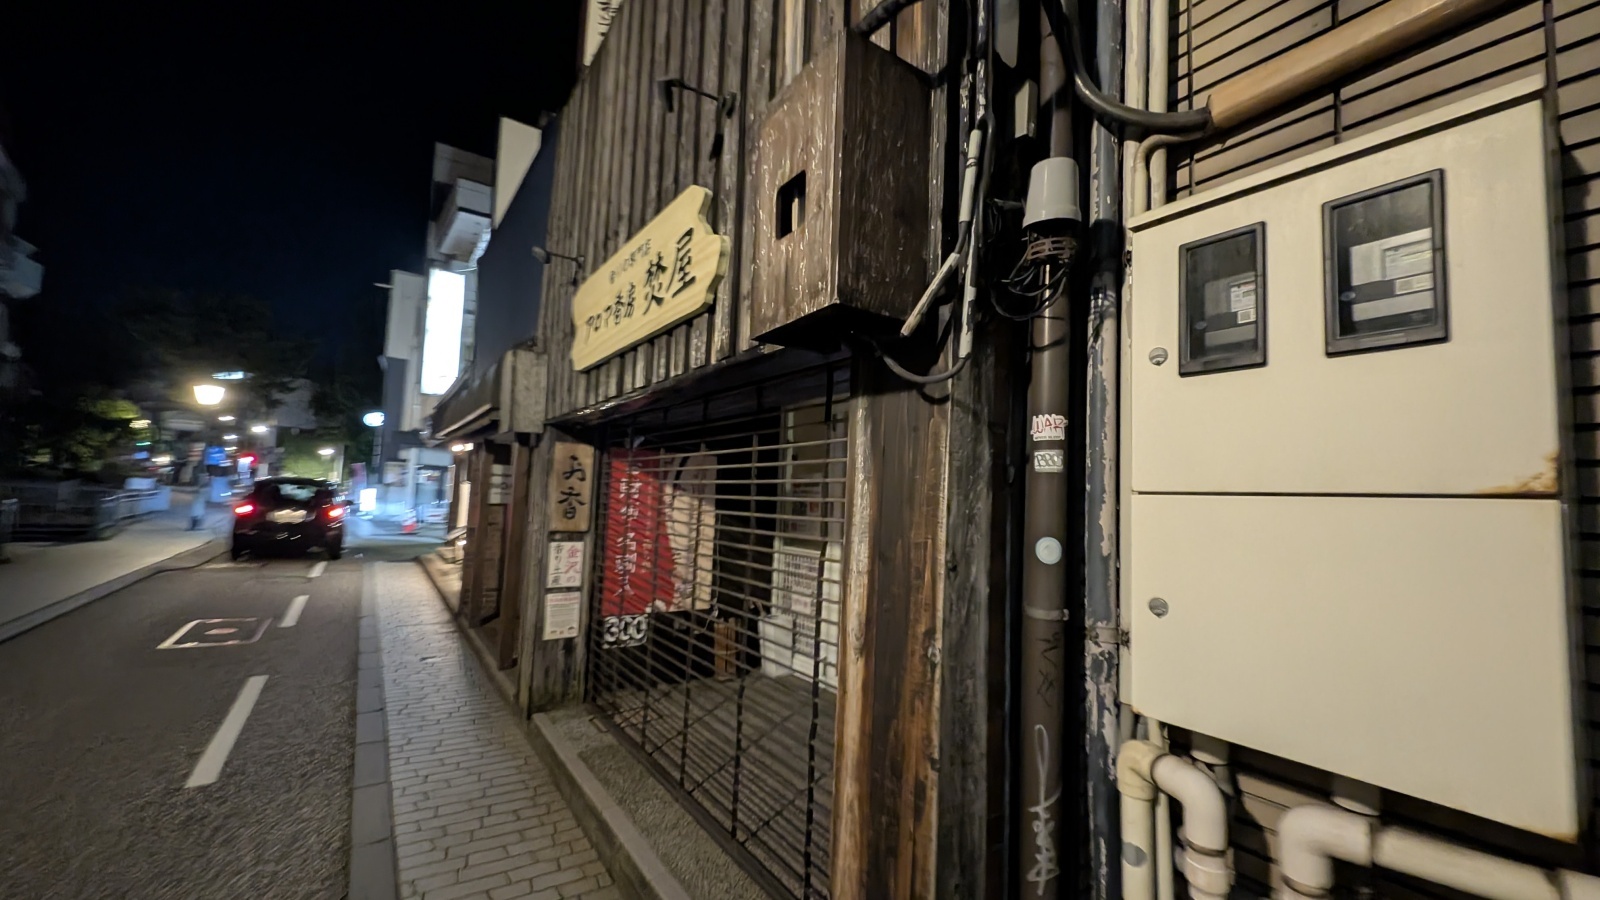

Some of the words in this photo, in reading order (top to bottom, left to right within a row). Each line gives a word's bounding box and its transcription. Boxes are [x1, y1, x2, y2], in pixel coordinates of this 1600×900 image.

[557, 454, 587, 520] お香
[564, 544, 581, 583] 金沢の
